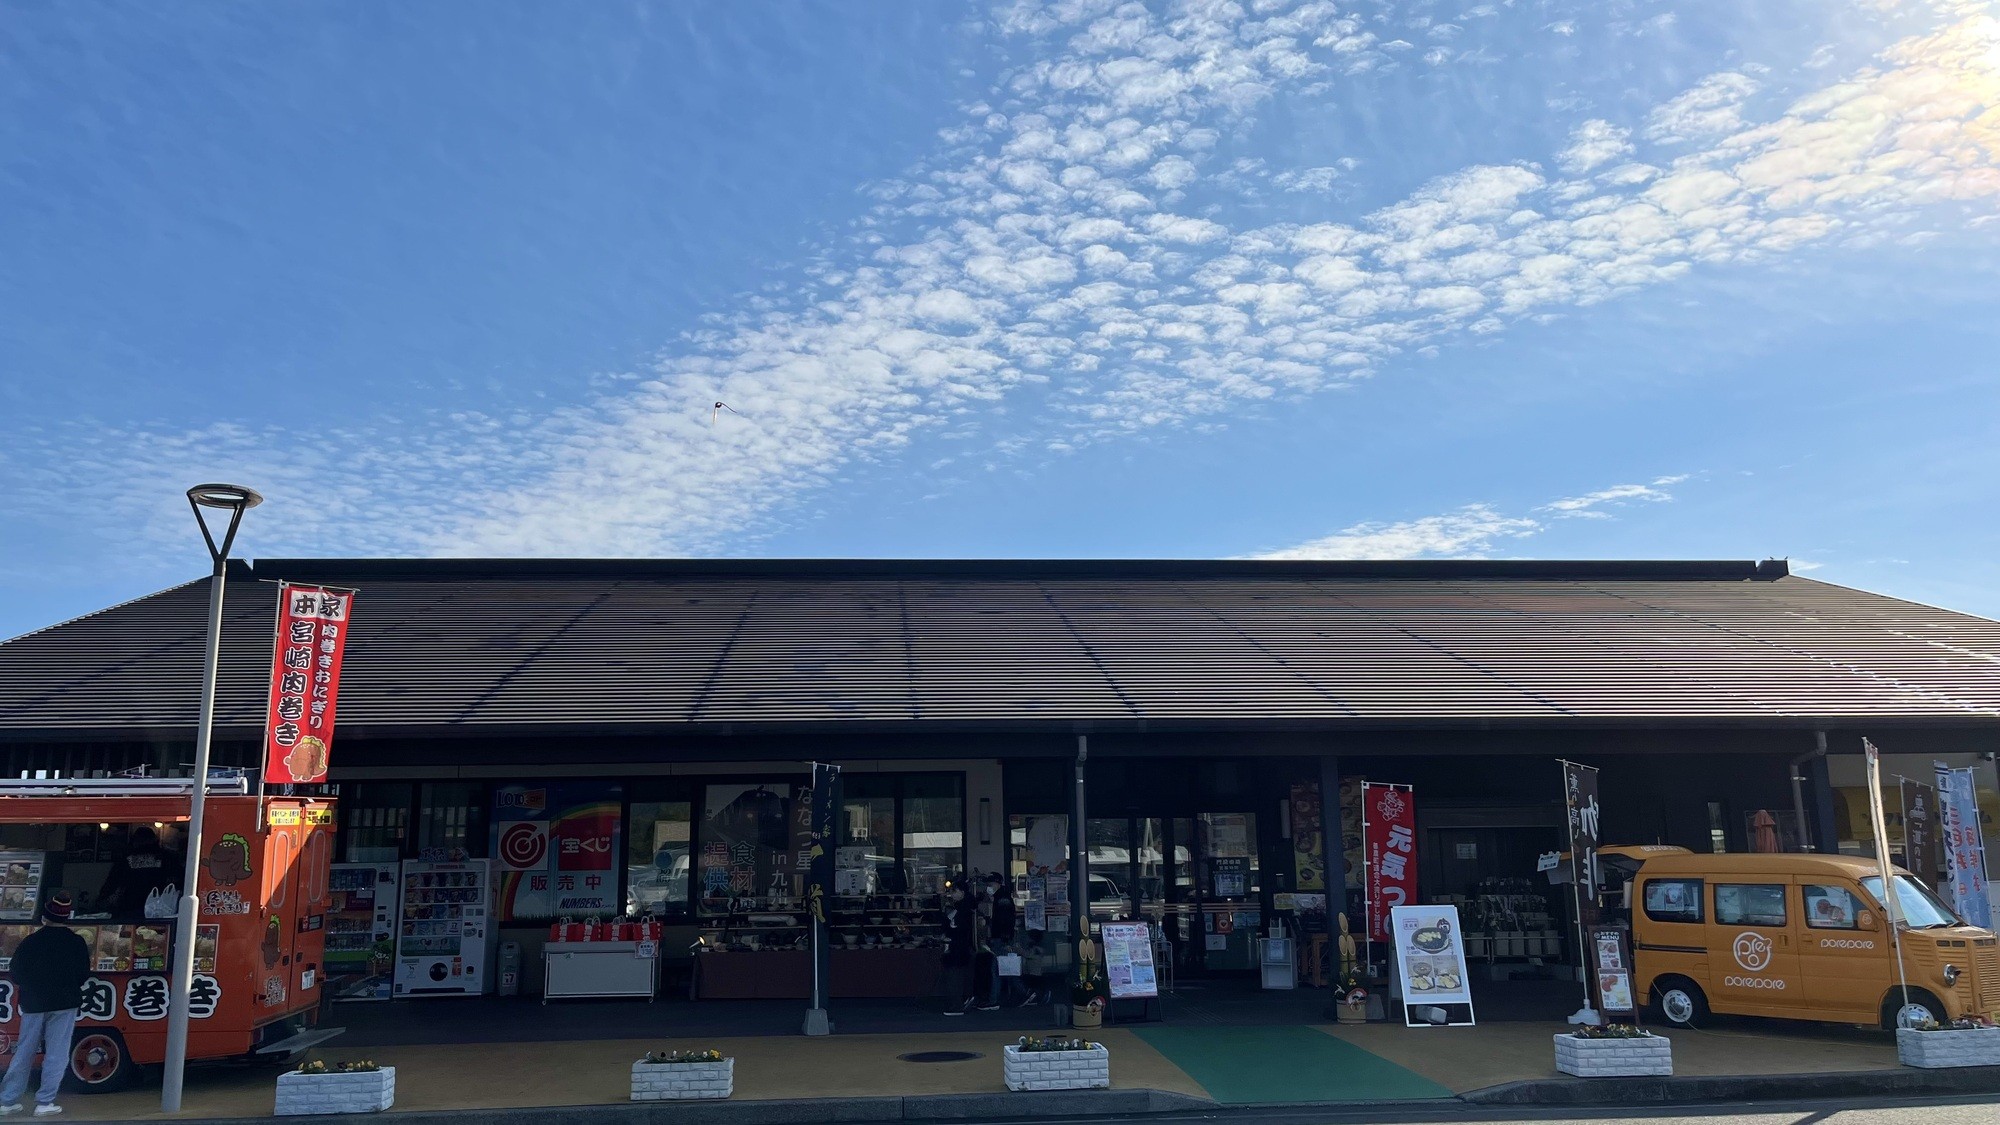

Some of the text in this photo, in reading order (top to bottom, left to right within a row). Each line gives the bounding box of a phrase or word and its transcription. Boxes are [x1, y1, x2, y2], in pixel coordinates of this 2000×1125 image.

[294, 595, 342, 617] 本家
[275, 620, 316, 747] 宮崎肉巻き
[309, 623, 339, 730] 肉巻きおにぎり
[561, 837, 611, 855] 宝くじ
[704, 840, 729, 893] 提供
[731, 840, 756, 892] 食材
[530, 876, 601, 891] 販売中
[559, 898, 602, 909] NUMBERS
[1821, 938, 1874, 950] porepore
[1725, 976, 1786, 990] porepore
